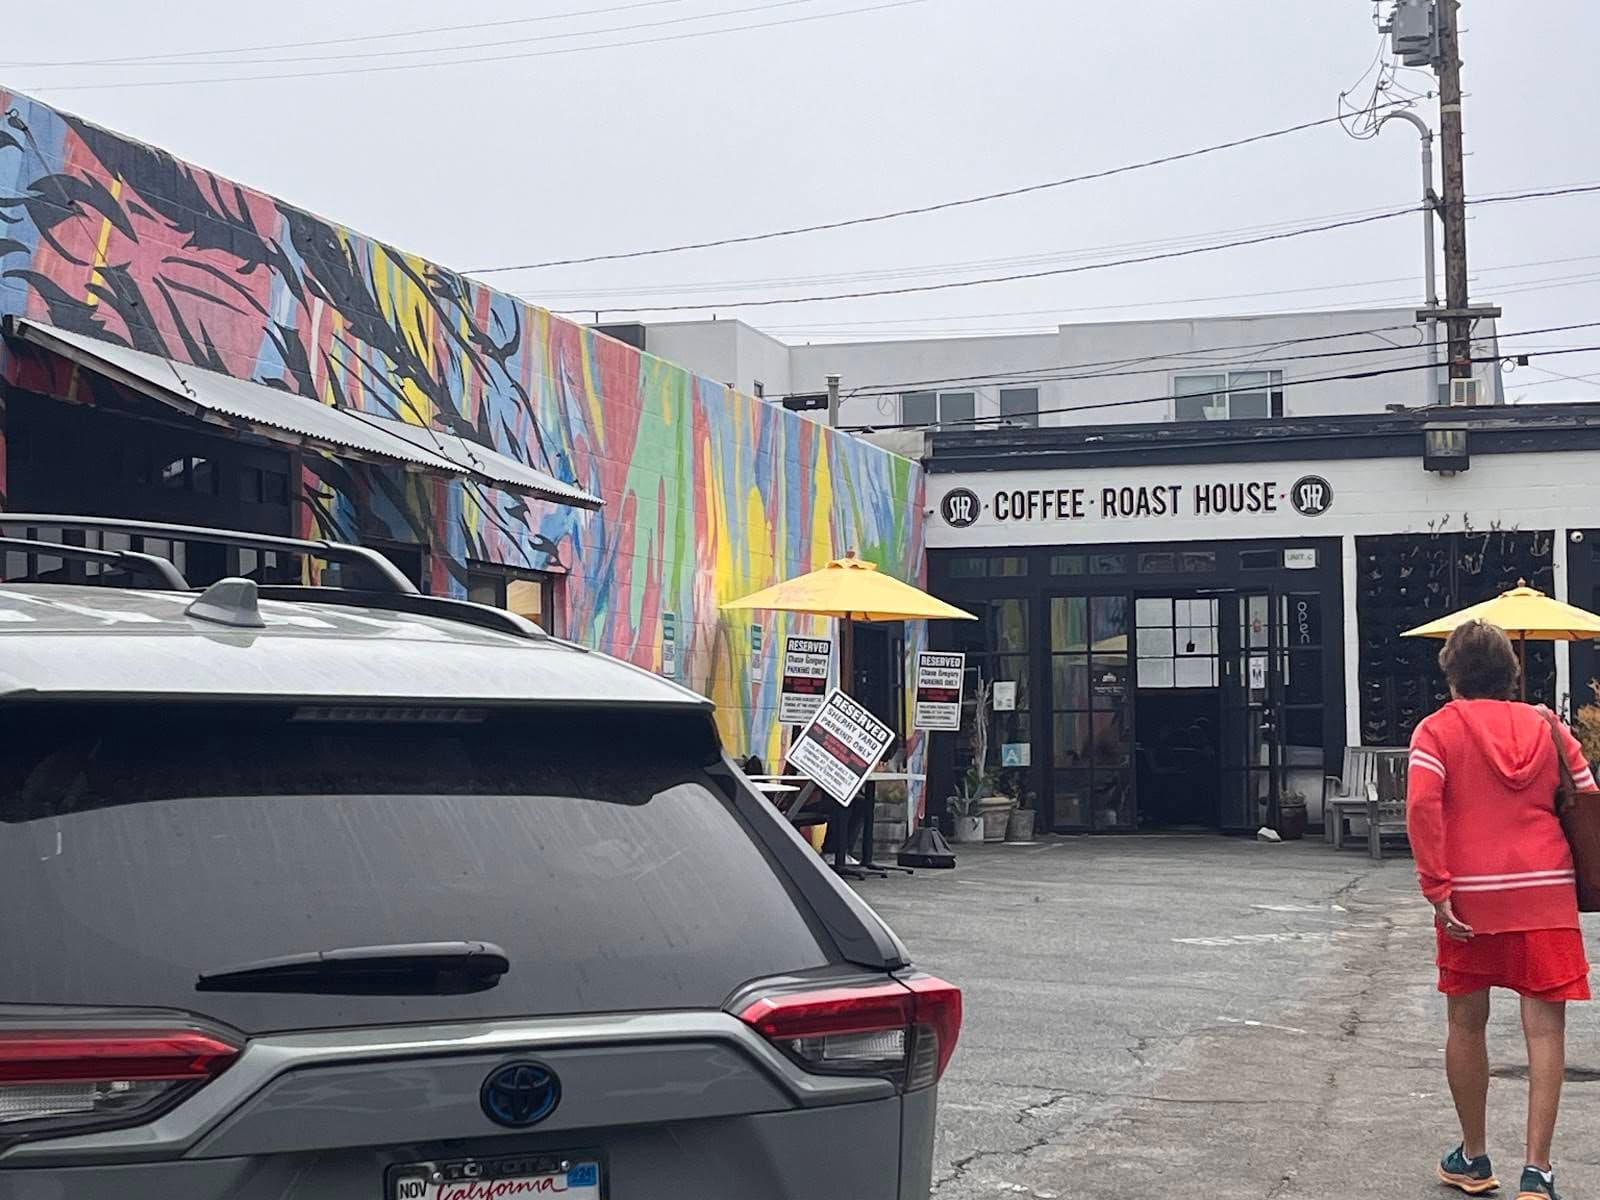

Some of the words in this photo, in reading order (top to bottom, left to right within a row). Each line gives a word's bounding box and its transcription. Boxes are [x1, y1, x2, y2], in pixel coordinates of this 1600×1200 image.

[994, 489, 1085, 520] COFFEE
[1102, 485, 1182, 517] ROAST
[1195, 482, 1277, 514] HOUSE
[1297, 601, 1310, 644] open
[788, 639, 829, 653] RESERVED
[787, 666, 810, 674] PARKING
[811, 667, 825, 675] ONLY
[921, 655, 961, 668] RESERVED
[920, 678, 943, 686] PARKING
[944, 679, 958, 687] ONLY
[827, 708, 857, 733] SHERRY
[858, 730, 878, 750] YARD
[832, 694, 888, 742] RESERVED
[821, 716, 853, 744] PARKING
[853, 741, 873, 758] ONLY
[400, 1181, 428, 1199] NOV
[436, 1177, 568, 1200] California
